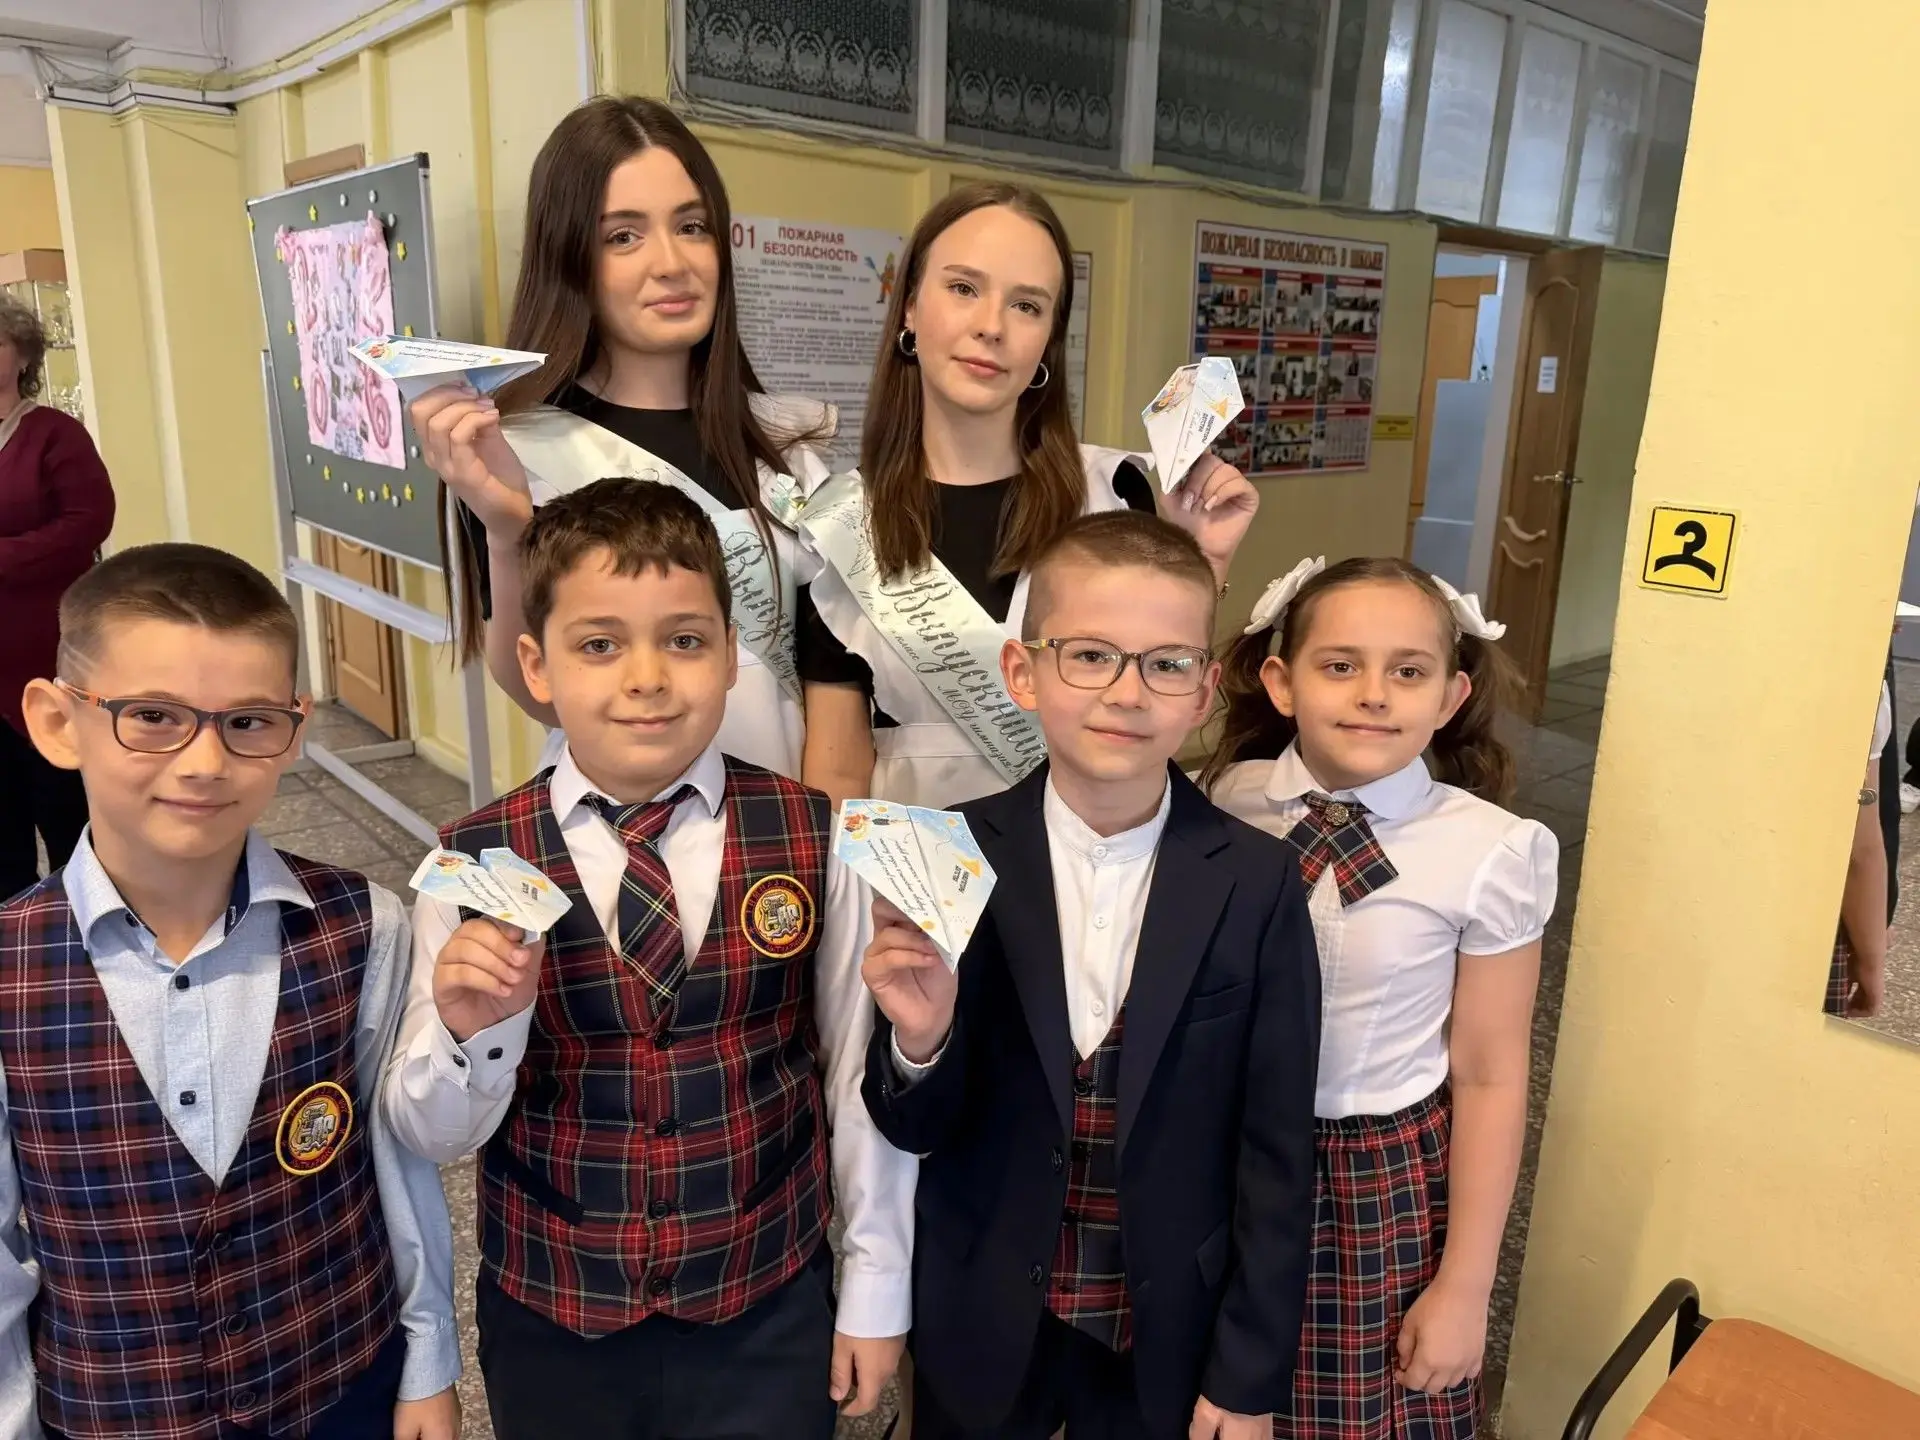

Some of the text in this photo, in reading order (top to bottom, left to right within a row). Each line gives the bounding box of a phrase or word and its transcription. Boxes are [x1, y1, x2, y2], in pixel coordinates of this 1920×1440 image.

[731, 223, 755, 249] 01
[778, 225, 845, 244] ПОЖАРНАЯ
[1201, 230, 1261, 260] ПОЖАРНАЯ
[763, 241, 859, 263] БЕЗОПАСНОСТЬ
